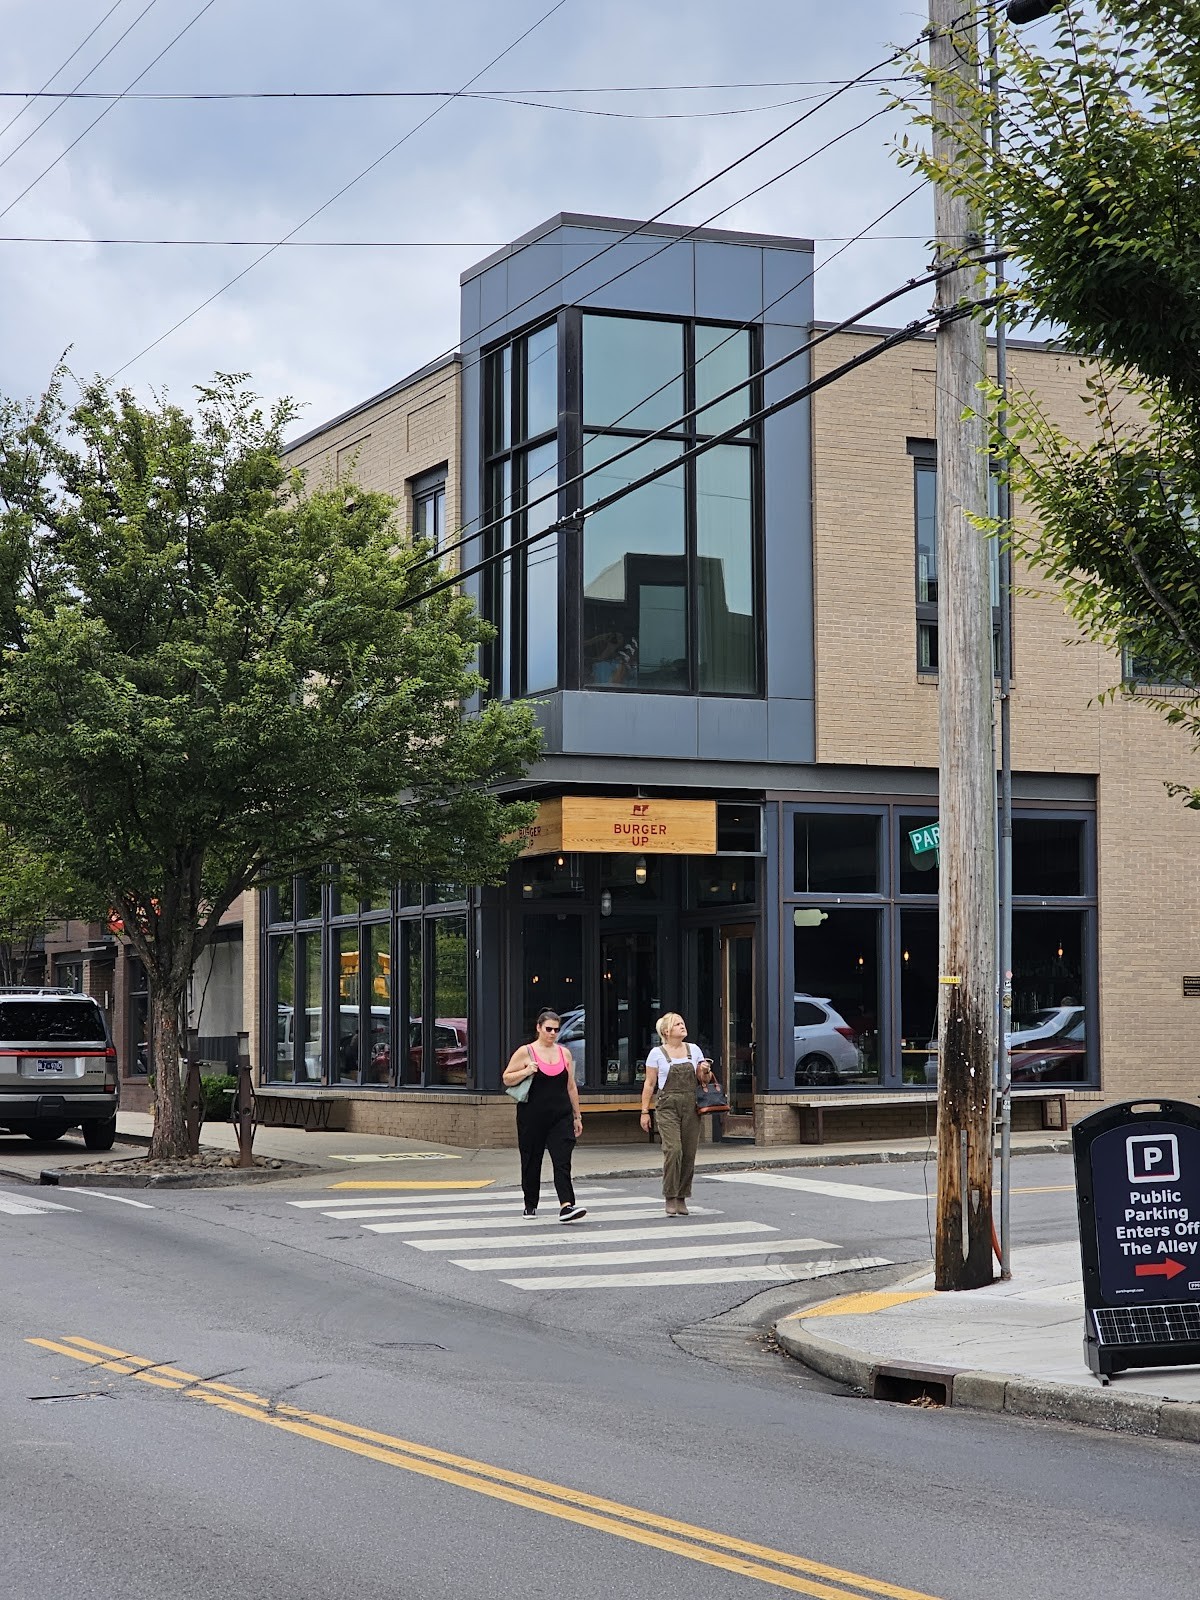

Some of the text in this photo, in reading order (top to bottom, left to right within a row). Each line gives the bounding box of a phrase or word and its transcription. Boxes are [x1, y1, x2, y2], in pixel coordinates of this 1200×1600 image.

[614, 823, 666, 835] BURGER
[632, 836, 649, 846] UP
[1143, 1147, 1163, 1171] P
[1130, 1189, 1182, 1205] Public
[1124, 1206, 1189, 1222] Parking
[1116, 1221, 1200, 1240] Enters Off
[1120, 1239, 1198, 1256] The Alley
